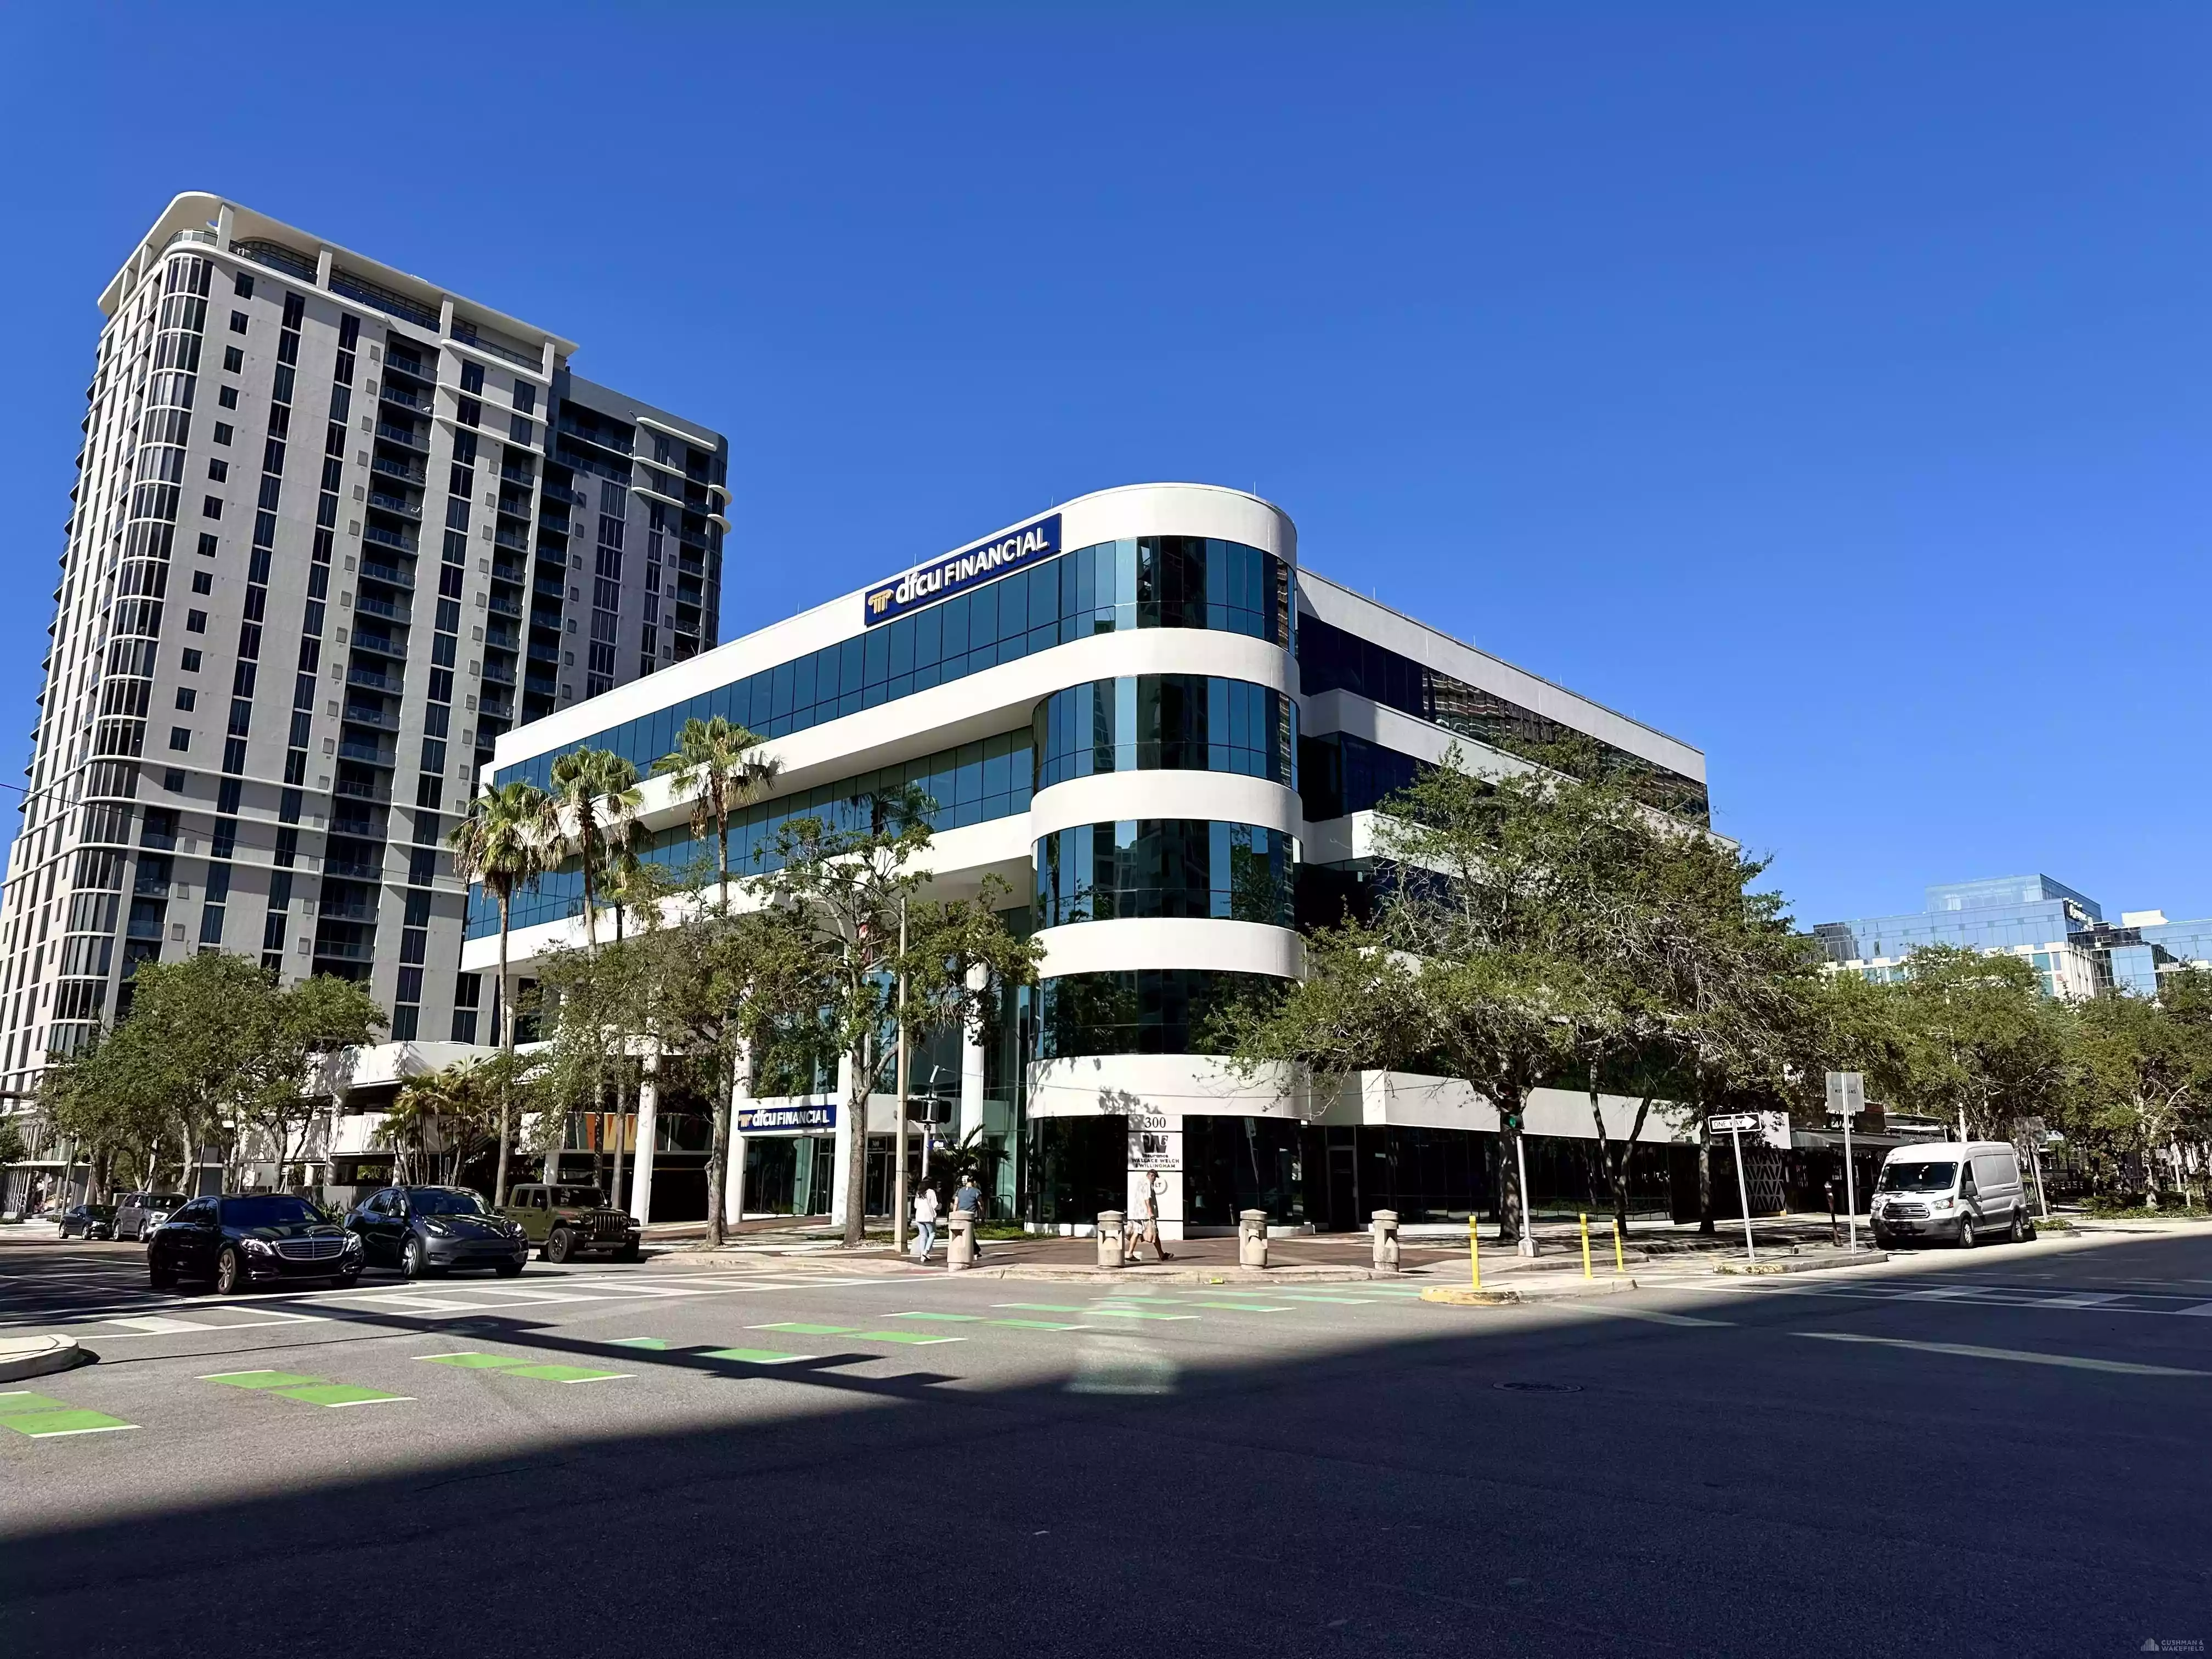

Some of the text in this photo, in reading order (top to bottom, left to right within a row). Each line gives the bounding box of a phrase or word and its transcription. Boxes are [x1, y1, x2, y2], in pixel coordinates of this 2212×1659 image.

[895, 527, 1049, 604] dfcu FINANCIAL
[752, 1109, 830, 1126] dfcu FINANCIAL
[1144, 1117, 1166, 1128] 300
